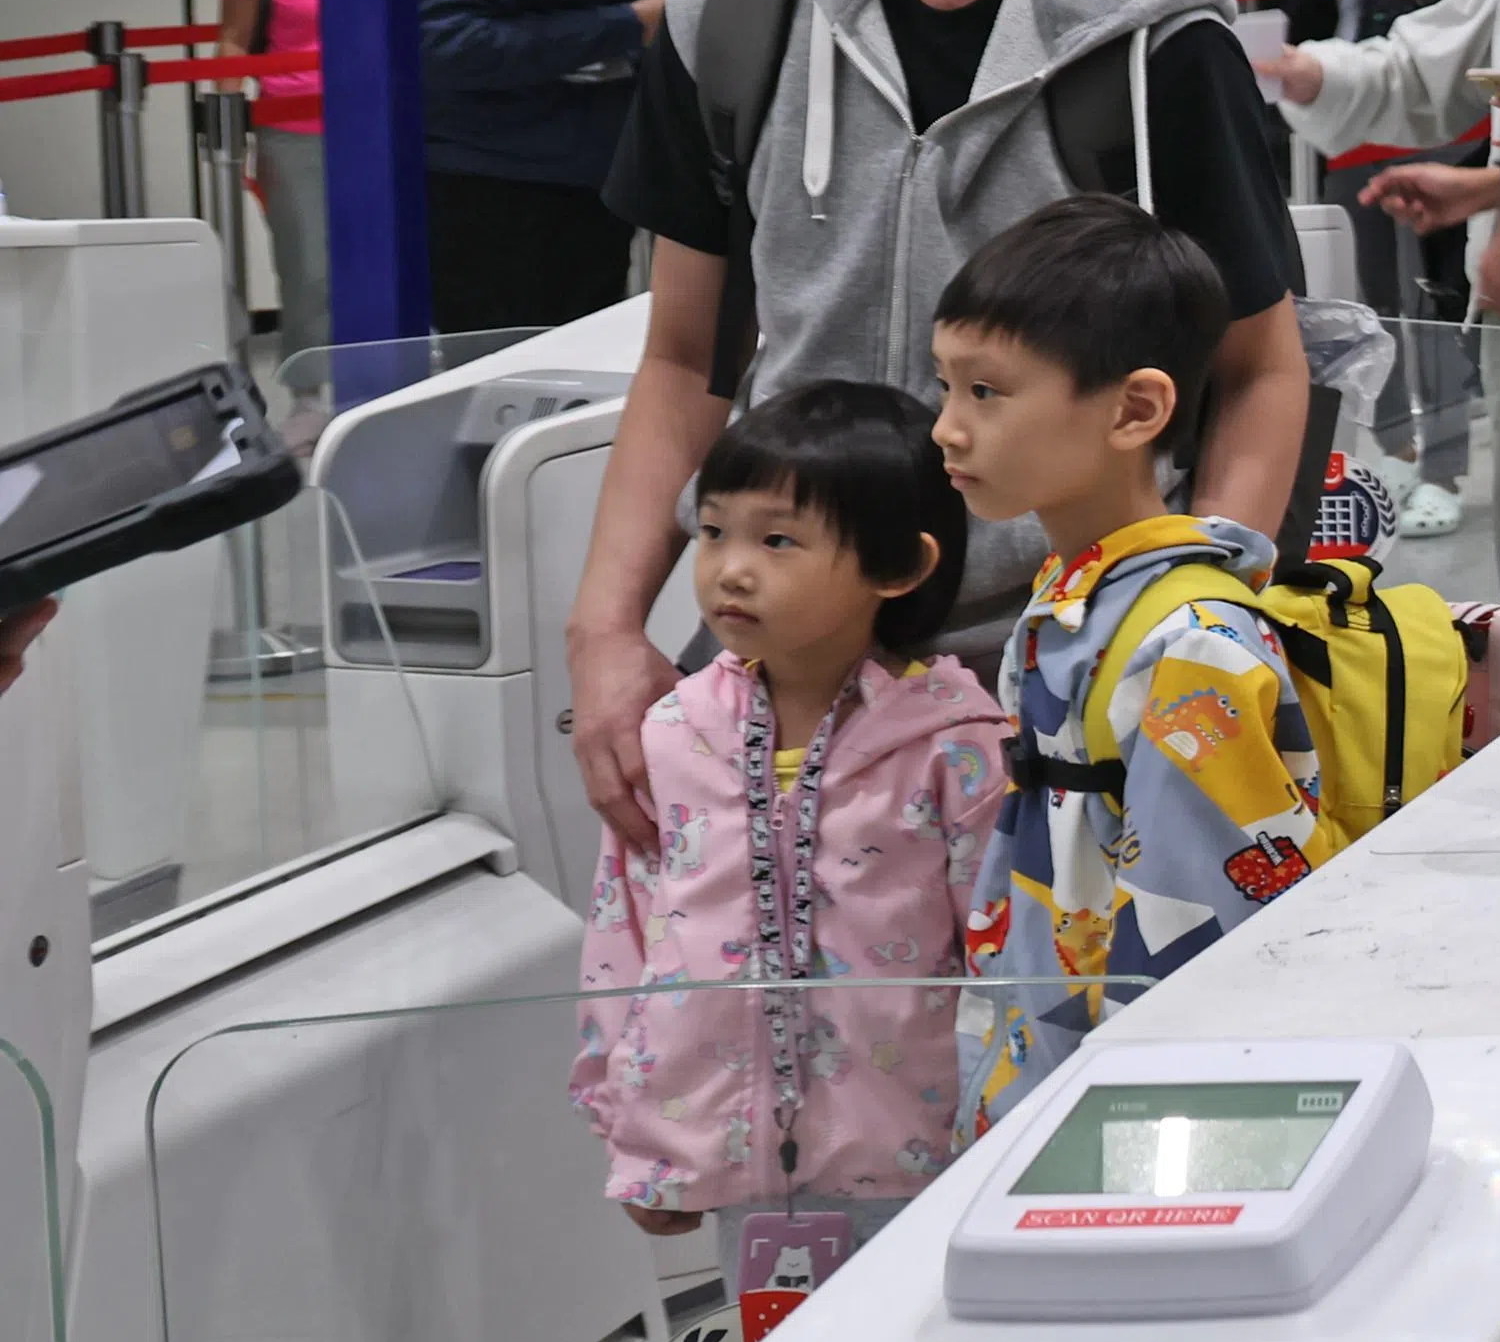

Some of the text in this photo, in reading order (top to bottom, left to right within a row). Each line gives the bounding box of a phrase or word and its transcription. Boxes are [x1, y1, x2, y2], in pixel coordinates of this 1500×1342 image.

[1025, 1206, 1233, 1227] SCAN QR HERE
